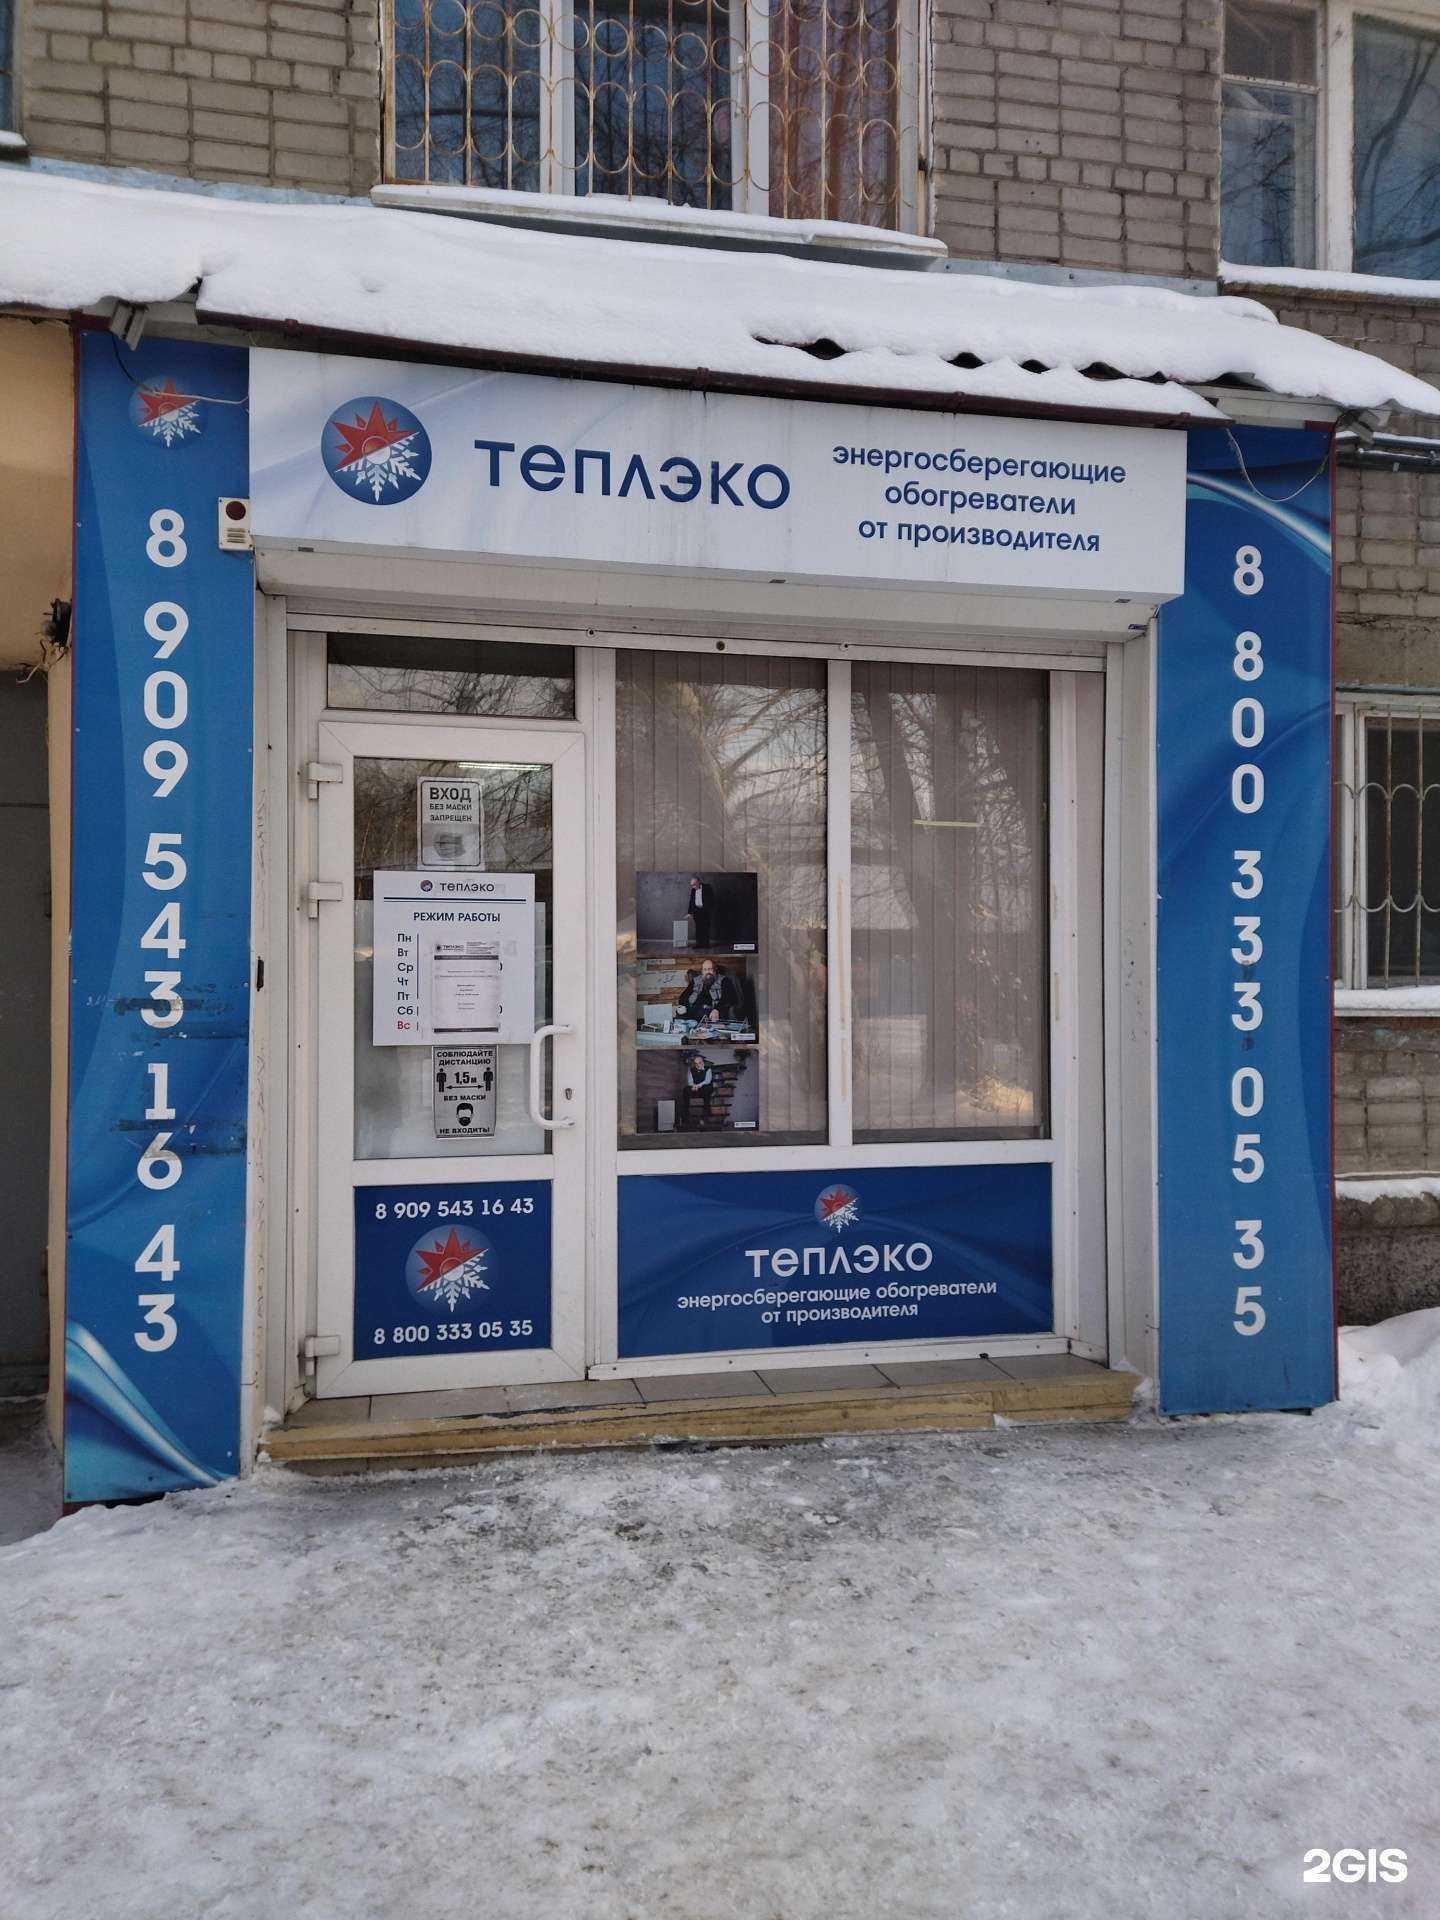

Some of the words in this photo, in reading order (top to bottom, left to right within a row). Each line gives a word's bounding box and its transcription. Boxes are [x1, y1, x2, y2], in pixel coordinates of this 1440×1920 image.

[832, 445, 1126, 484] энергосберегающие
[884, 480, 1076, 515] обогреватели
[145, 508, 188, 568] 8
[858, 519, 888, 539] от
[897, 521, 1100, 552] производителя
[1233, 544, 1265, 596] 8
[142, 600, 190, 798] 909
[1231, 630, 1265, 816] 800
[429, 786, 472, 803] ВХОД
[429, 814, 472, 822] ЗАПРЕЩЕН
[445, 803, 472, 811] МАСКИ
[413, 912, 455, 922] РЕЖИМ
[458, 912, 501, 923] РАБОТЫ
[140, 832, 188, 1029] 543
[397, 933, 412, 943] Пн
[1231, 849, 1264, 1032] 333
[397, 948, 409, 957] Вт
[397, 962, 414, 973] Ср
[397, 977, 409, 986] Чт
[397, 991, 410, 1001] Пт
[397, 1006, 414, 1015] Сб
[397, 1020, 411, 1030] Вс
[436, 1050, 493, 1058] СОБЛЮДАЙТЕ
[136, 1062, 183, 1190] 16
[1231, 1066, 1265, 1184] 05
[375, 1203, 387, 1219] 8
[394, 1201, 431, 1218] 909
[437, 1200, 474, 1217] 543
[481, 1199, 504, 1215] 16
[510, 1198, 534, 1214] 43
[133, 1224, 181, 1353] 43
[1232, 1219, 1267, 1337] 35
[677, 1287, 871, 1311] энергосберегающие
[876, 1282, 997, 1299] обогреватели
[761, 1308, 781, 1324] от
[786, 1304, 919, 1326] производителя
[374, 1328, 386, 1344] 8
[393, 1325, 430, 1343] 800
[436, 1323, 472, 1341] 333
[479, 1321, 503, 1338] 05
[509, 1320, 533, 1336] 35
